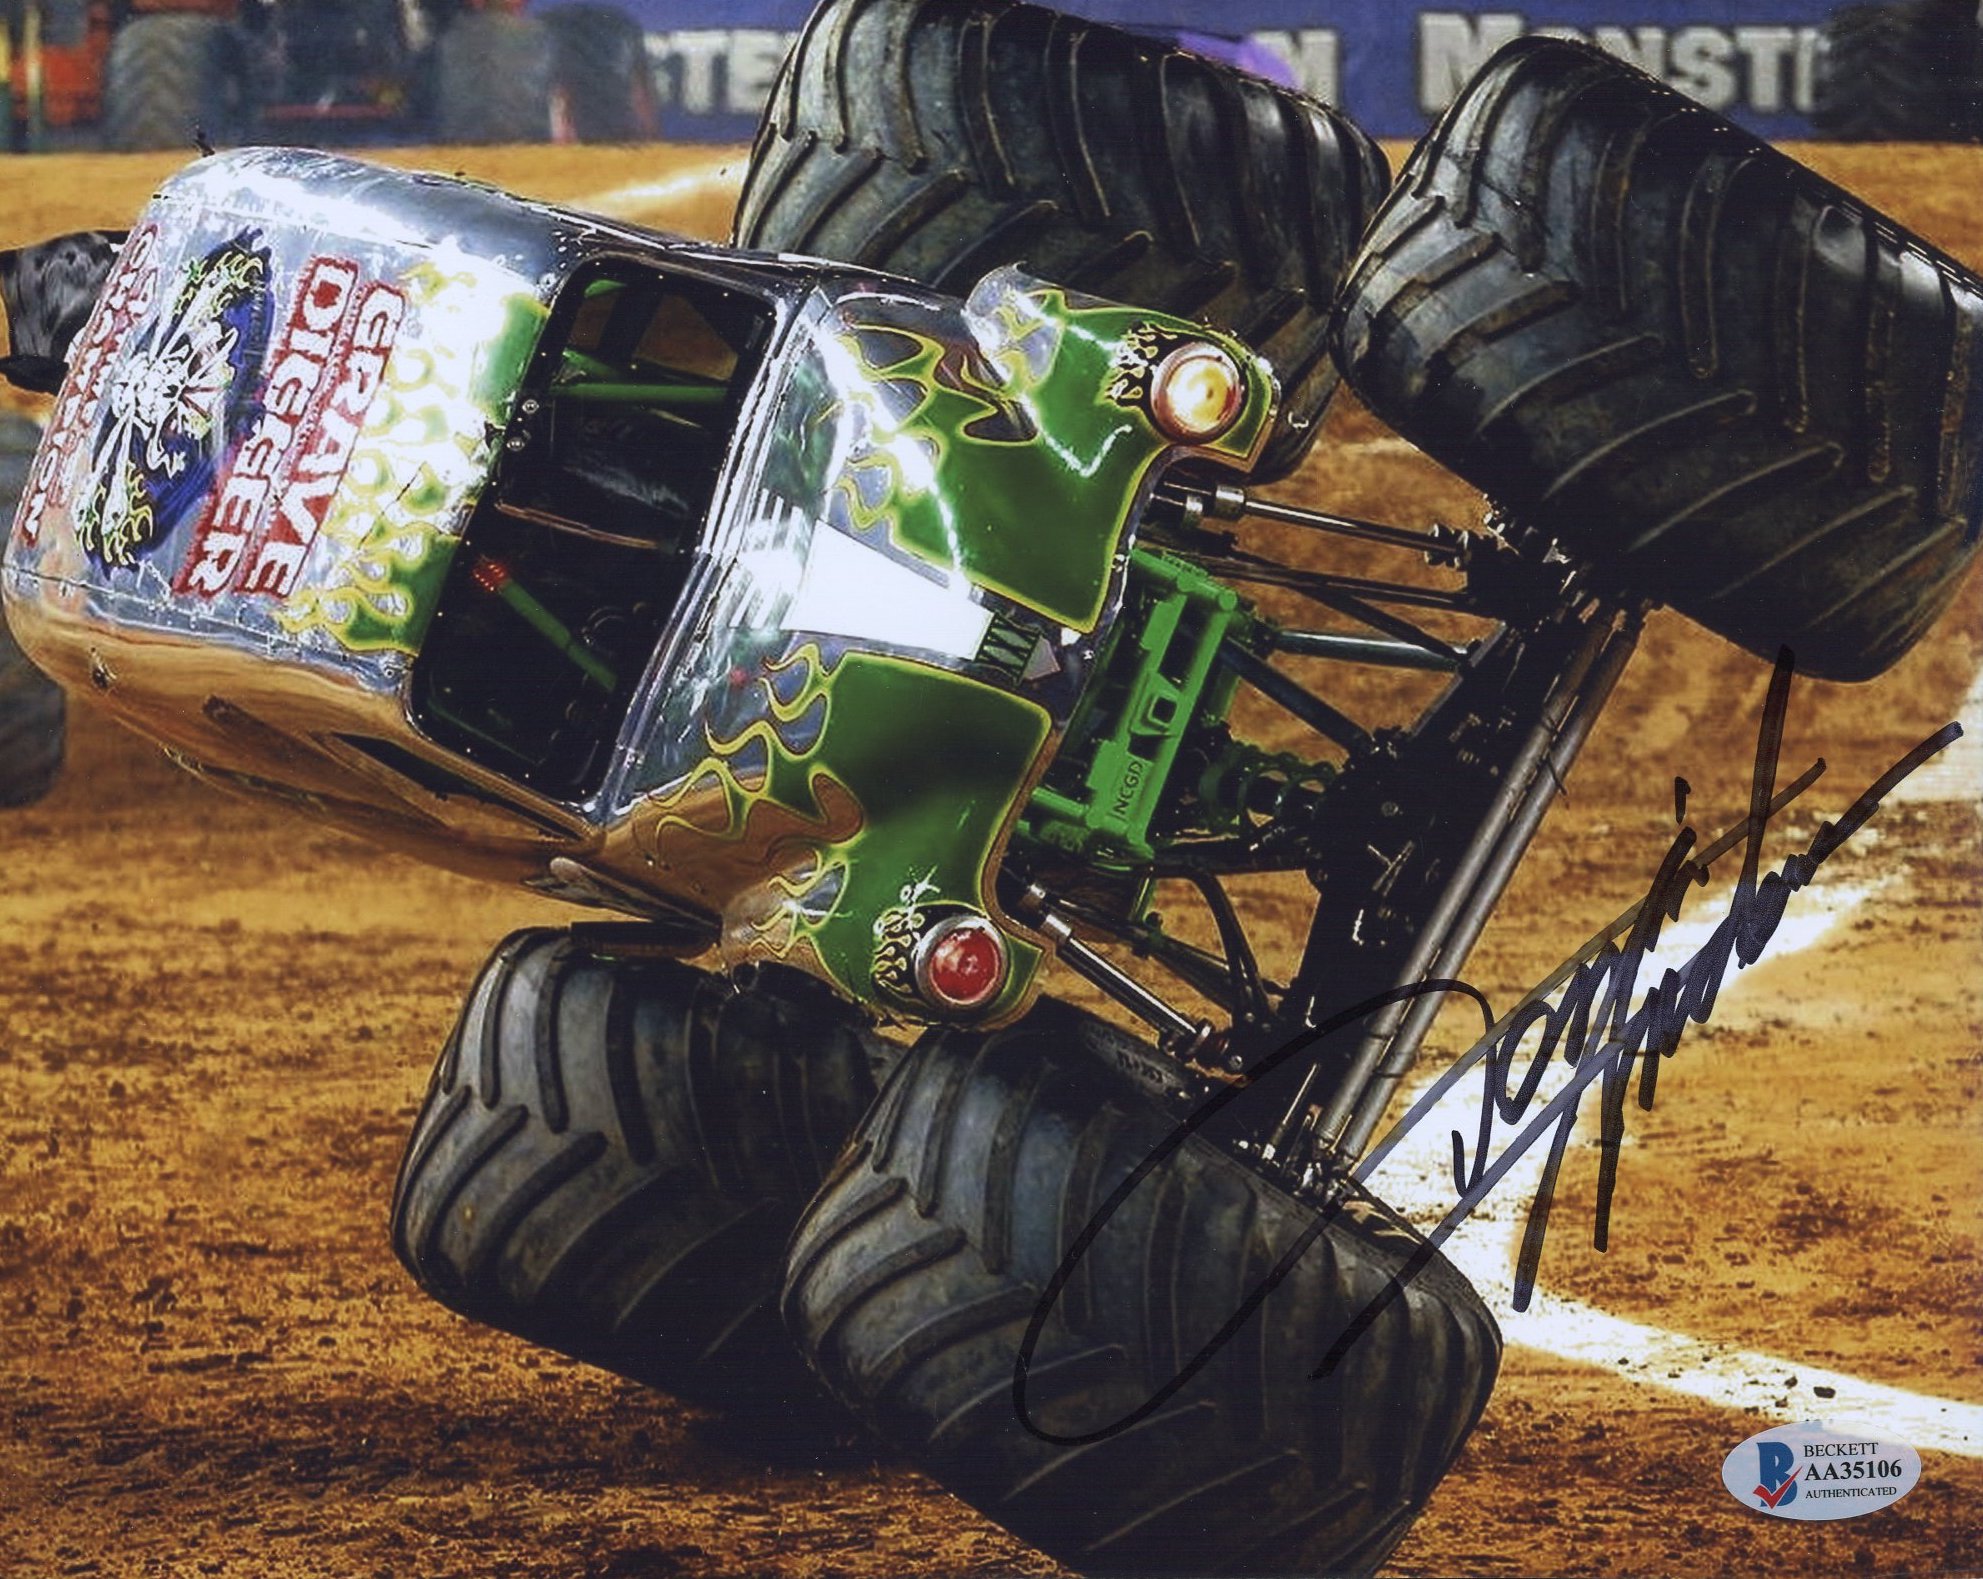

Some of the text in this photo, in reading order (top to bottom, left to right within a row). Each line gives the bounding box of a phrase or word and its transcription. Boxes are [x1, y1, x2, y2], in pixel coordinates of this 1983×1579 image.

[25, 228, 155, 537] CHAMPION
[184, 260, 358, 594] DIGGER
[243, 284, 404, 596] GRAVE
[1804, 1442, 1879, 1458] BECKETT
[1804, 1459, 1902, 1481] AA35106
[1805, 1486, 1897, 1500] AUTHENTICATED
